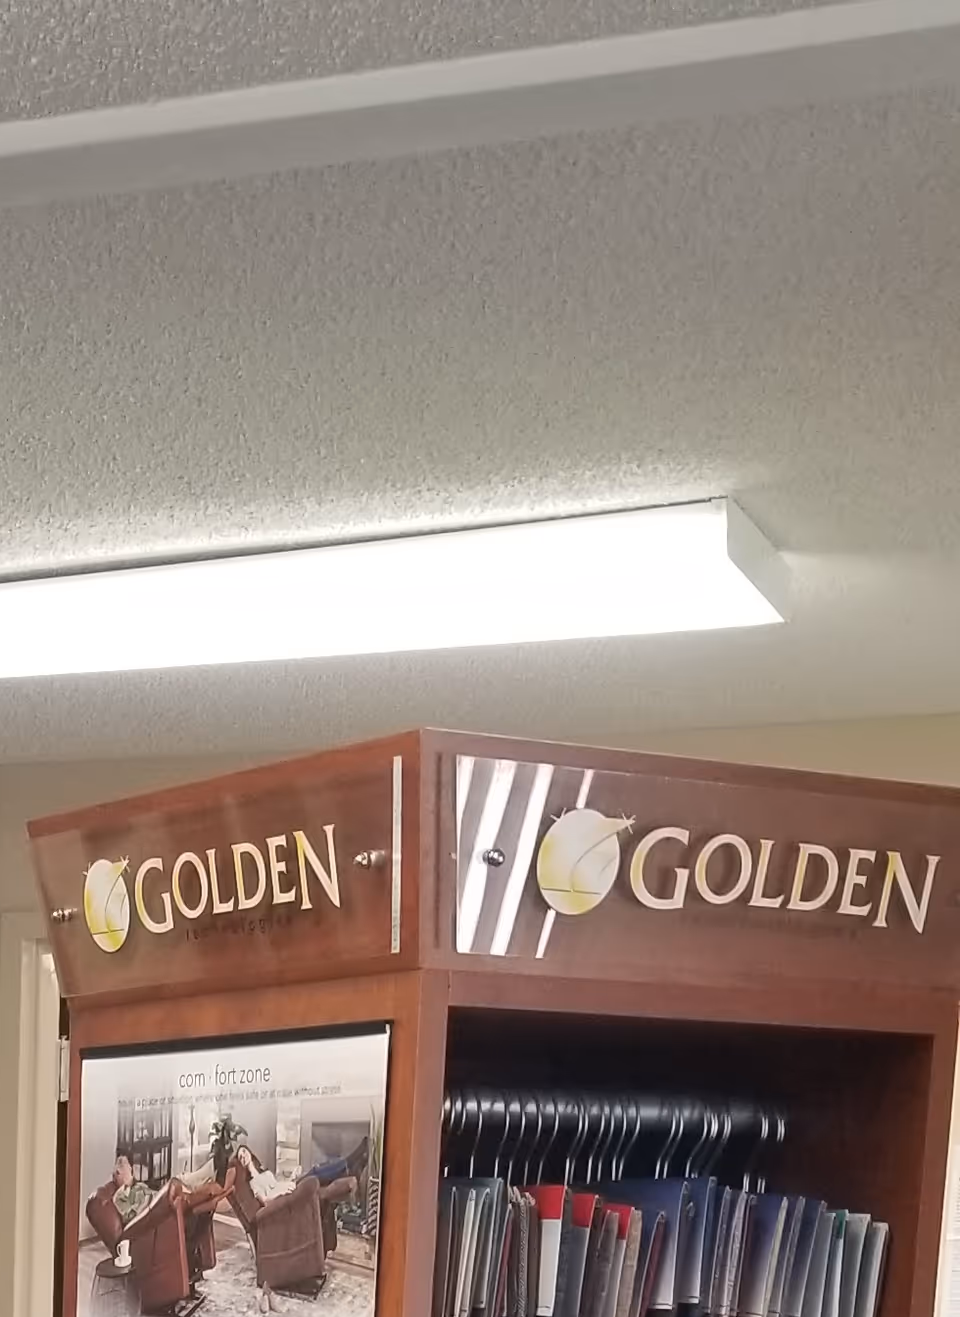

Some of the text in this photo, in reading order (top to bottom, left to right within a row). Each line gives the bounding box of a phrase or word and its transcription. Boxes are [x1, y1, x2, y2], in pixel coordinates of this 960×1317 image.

[135, 824, 341, 934] GOLDEN
[630, 827, 940, 934] GOLDEN
[178, 1064, 271, 1088] com fort zone
